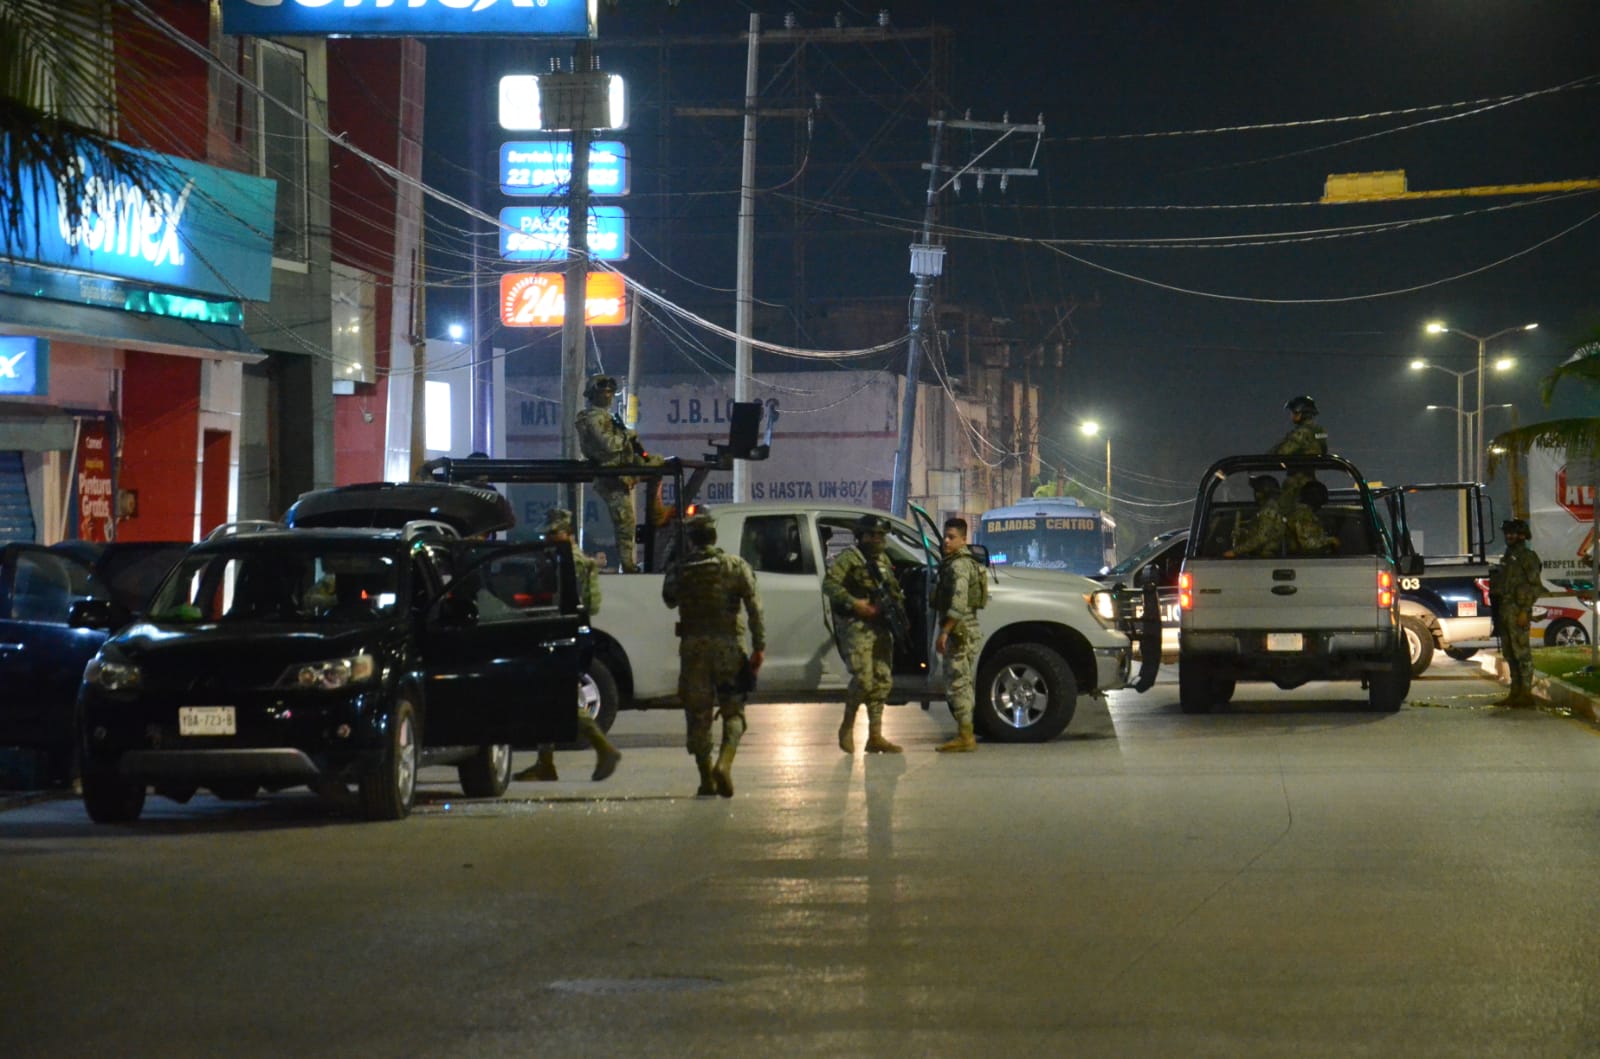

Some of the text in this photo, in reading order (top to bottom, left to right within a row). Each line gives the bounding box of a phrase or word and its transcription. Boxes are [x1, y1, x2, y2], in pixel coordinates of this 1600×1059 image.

[769, 480, 813, 499] HASTA
[818, 481, 837, 499] UN
[987, 518, 1094, 533] BAJADAS CENTRO
